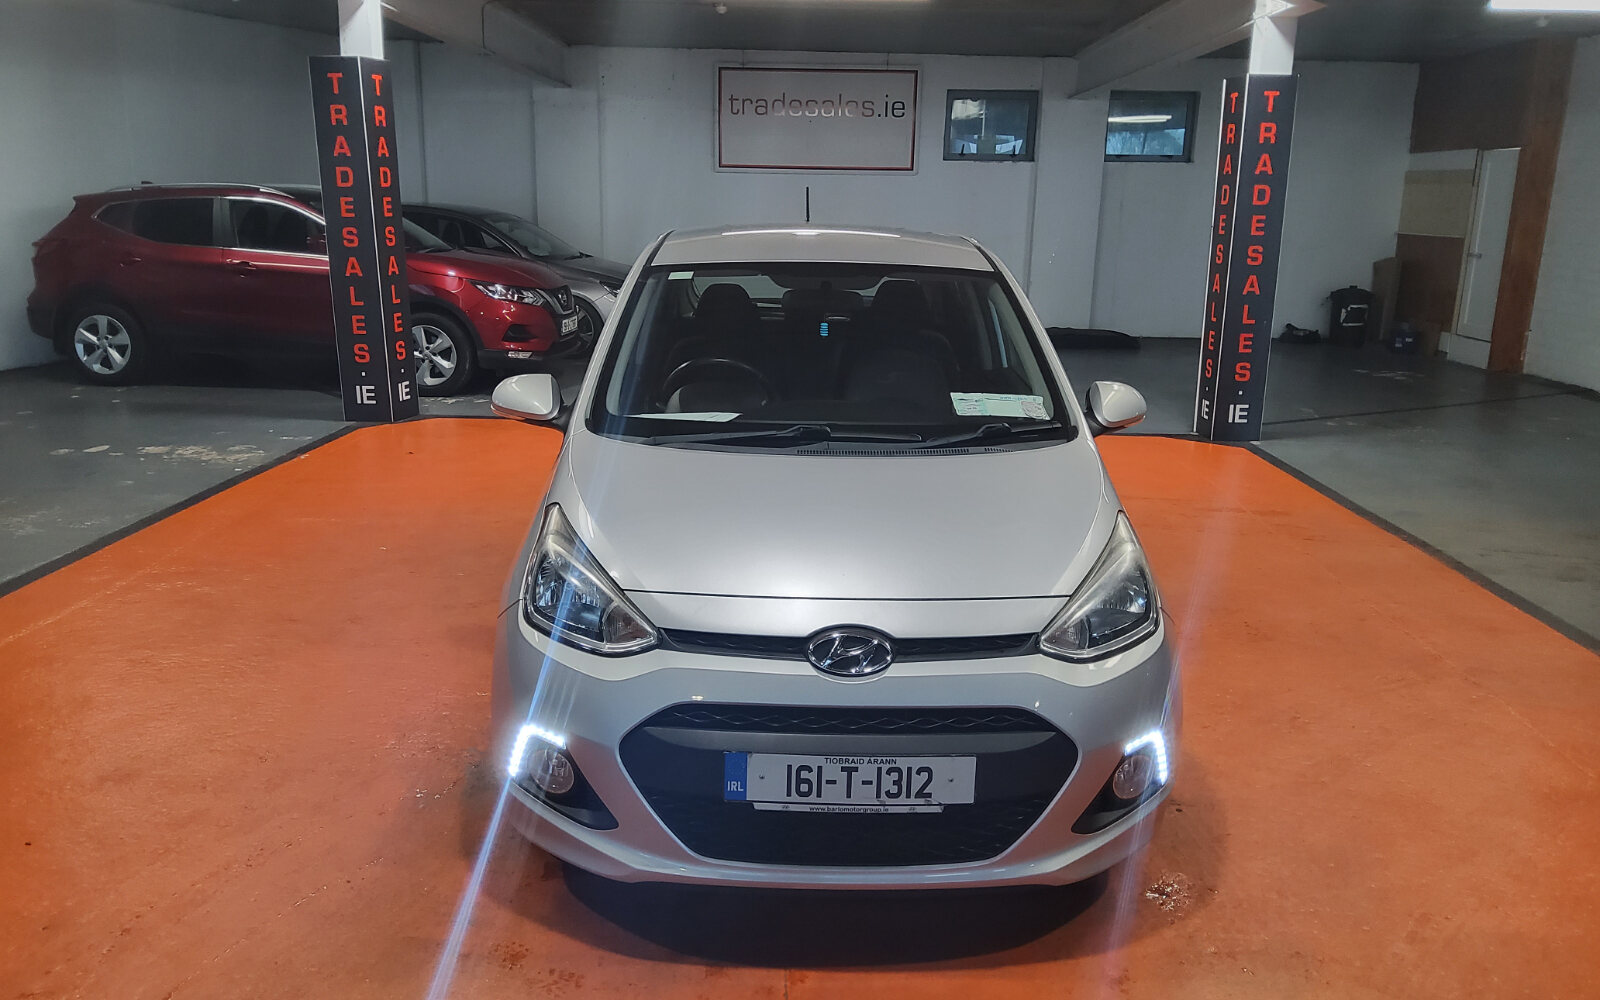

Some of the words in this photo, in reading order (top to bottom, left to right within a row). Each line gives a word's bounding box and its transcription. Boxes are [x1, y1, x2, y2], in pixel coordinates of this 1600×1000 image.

[729, 92, 906, 118] tradesales.ie
[327, 72, 377, 404] TRADESALES.IE
[371, 74, 411, 401] TRADESALES.IE
[1201, 92, 1239, 420] TRADESALES.IE
[1227, 91, 1280, 423] TRADESALES.IE
[727, 781, 744, 791] IRL
[786, 764, 934, 799] 161-T-1312
[824, 757, 865, 765] TIOBRAID
